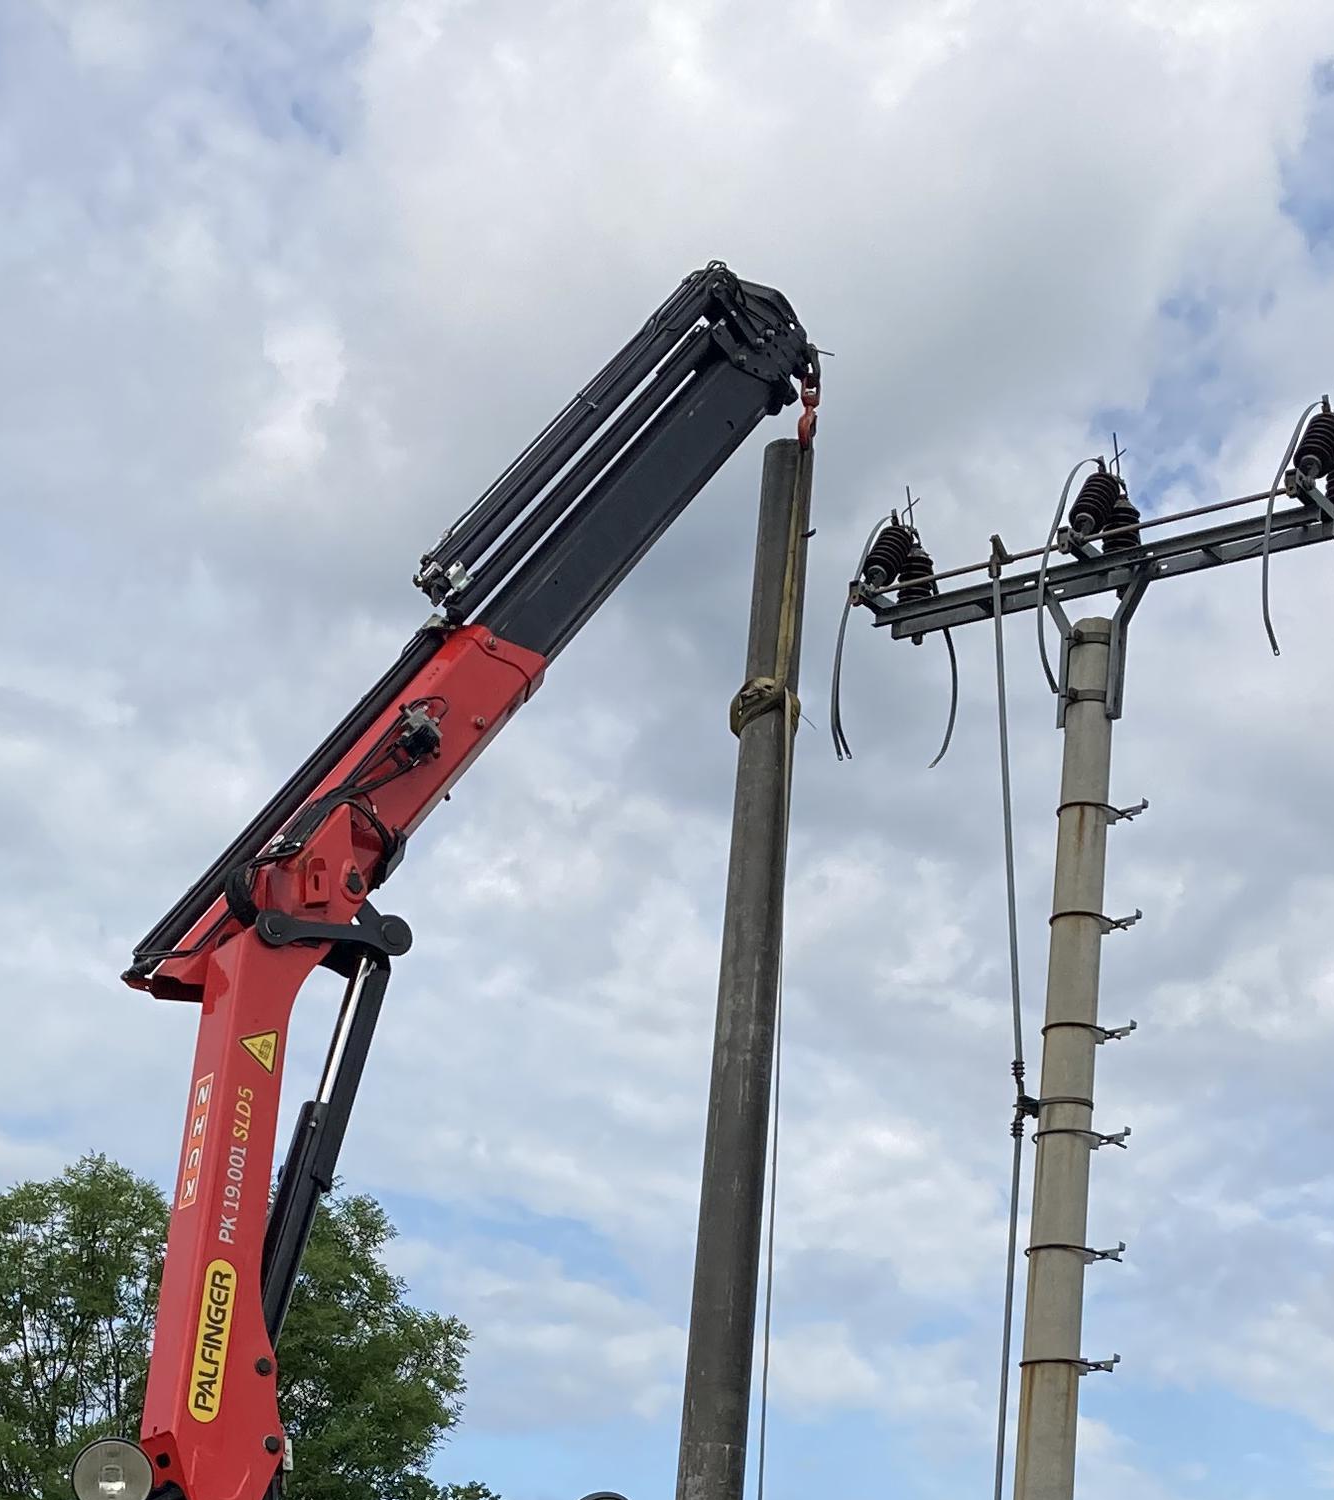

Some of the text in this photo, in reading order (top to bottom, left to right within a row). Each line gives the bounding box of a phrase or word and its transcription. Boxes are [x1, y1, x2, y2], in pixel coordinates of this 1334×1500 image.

[184, 1084, 210, 1201] KUHN
[223, 1146, 247, 1212] 19.001
[218, 1214, 238, 1245] PK
[193, 1269, 232, 1413] PALFINGER
